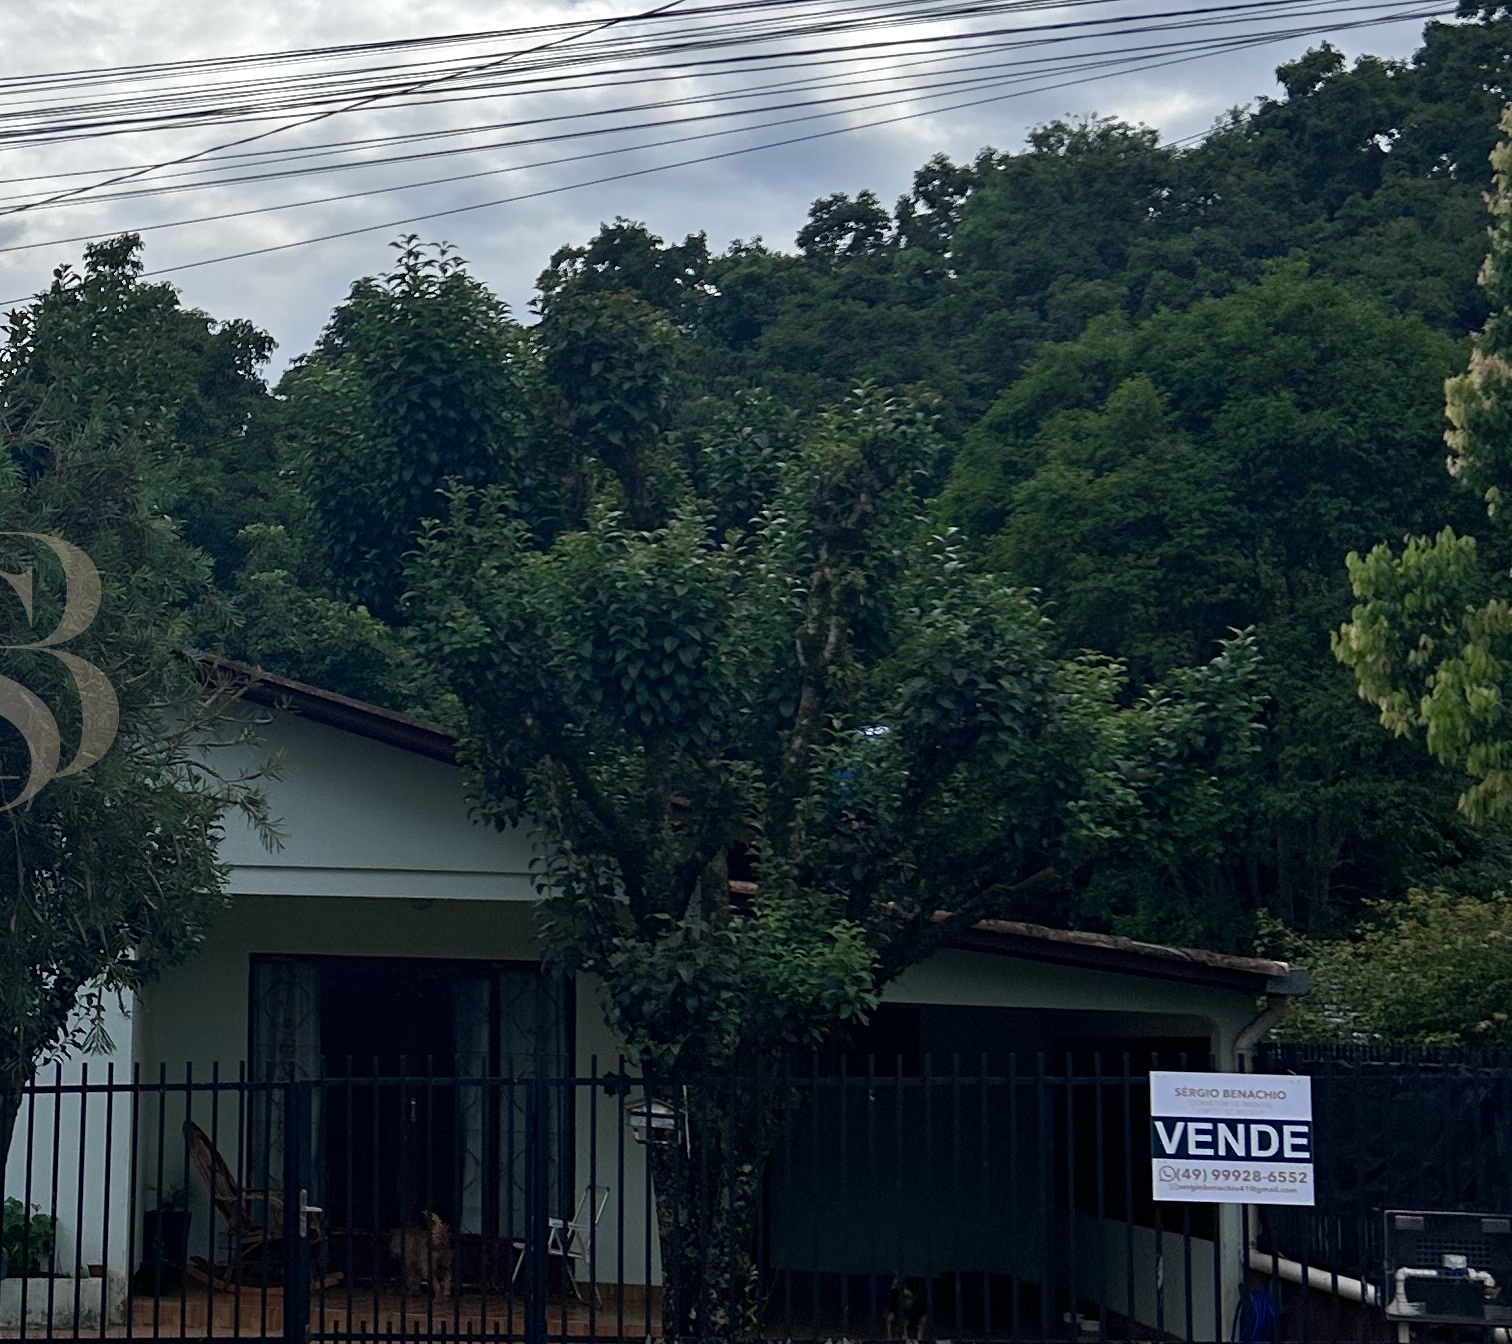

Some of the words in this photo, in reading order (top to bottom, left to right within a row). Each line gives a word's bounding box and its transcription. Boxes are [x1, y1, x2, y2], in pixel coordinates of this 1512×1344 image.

[1223, 1089, 1287, 1100] BENACHIO
[1154, 1121, 1311, 1159] VENDE
[1176, 1168, 1207, 1182] (49)
[1211, 1169, 1308, 1184] 99928-6552
